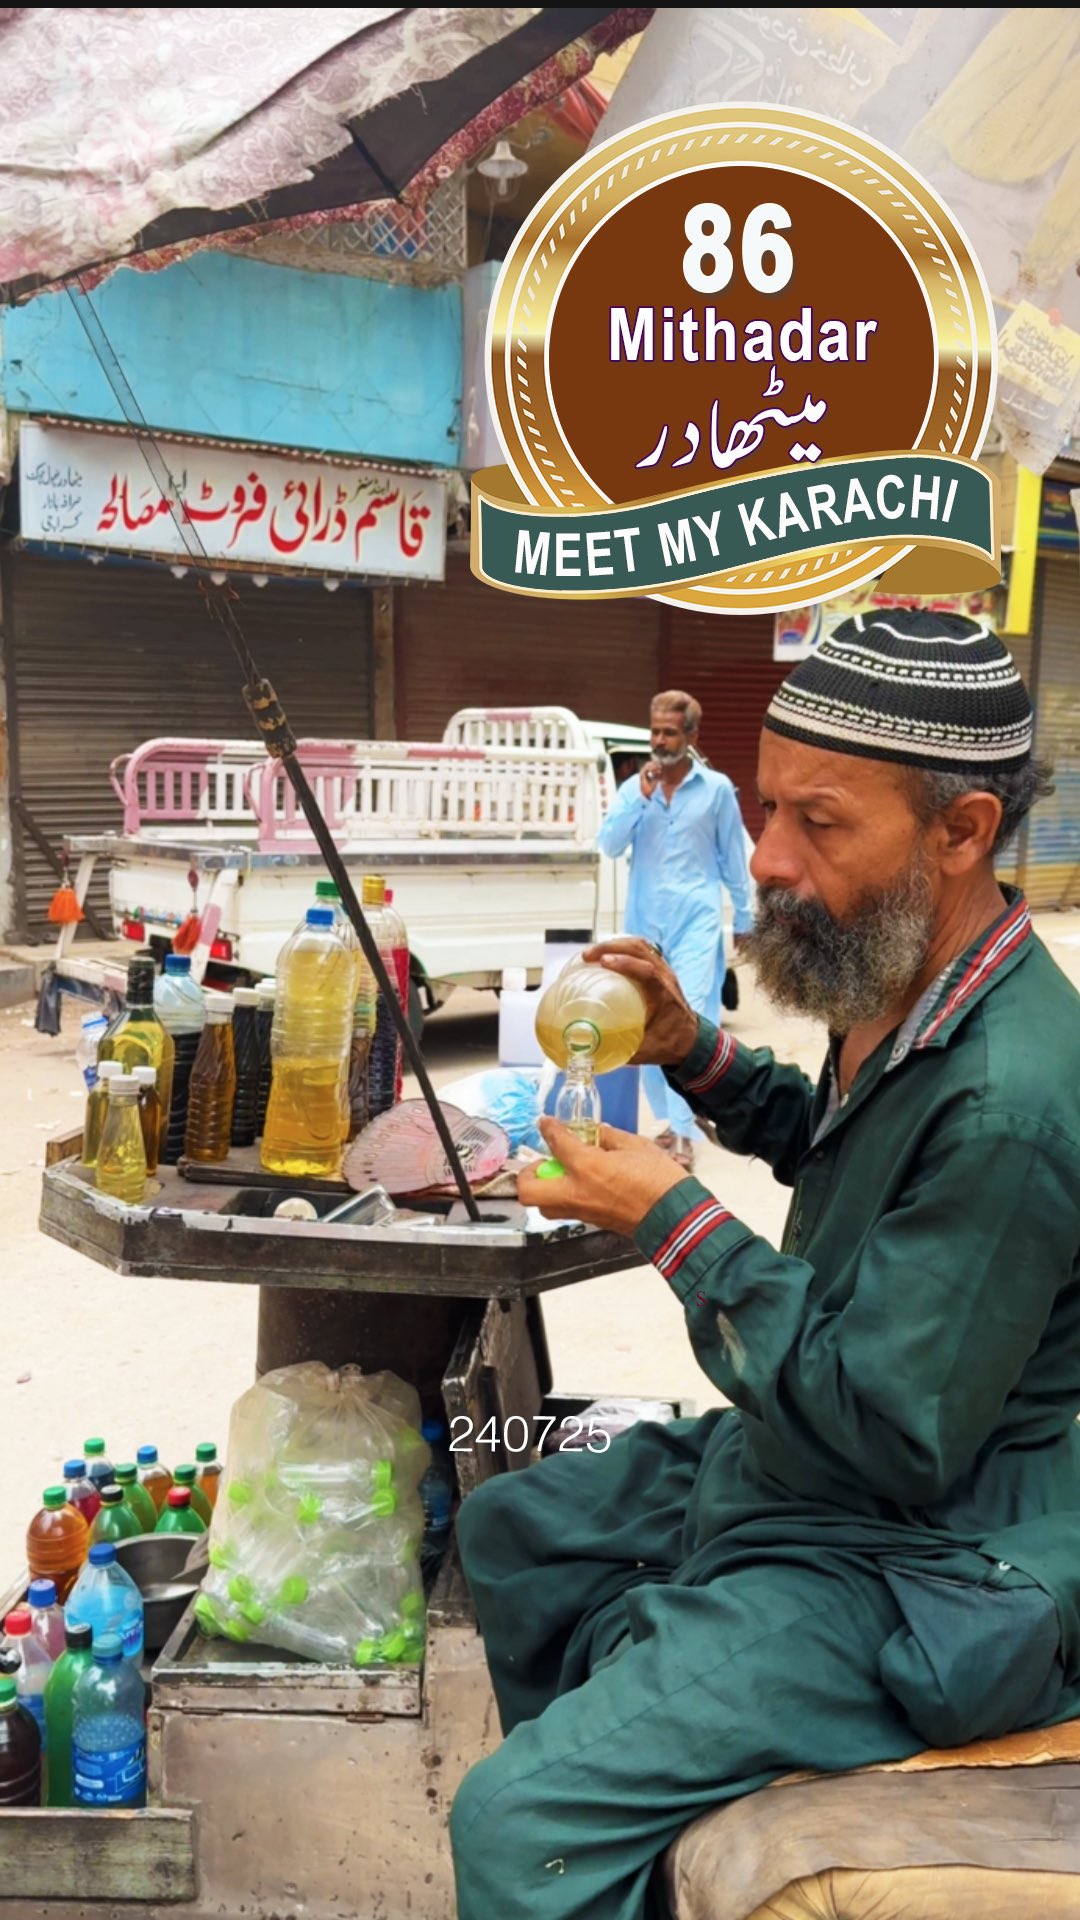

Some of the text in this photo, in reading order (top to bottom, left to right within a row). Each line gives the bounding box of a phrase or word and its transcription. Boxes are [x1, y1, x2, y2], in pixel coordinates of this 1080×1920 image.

[181, 471, 268, 549] فروٹ
[269, 475, 347, 553] ڈرائی
[355, 486, 431, 562] قاسم
